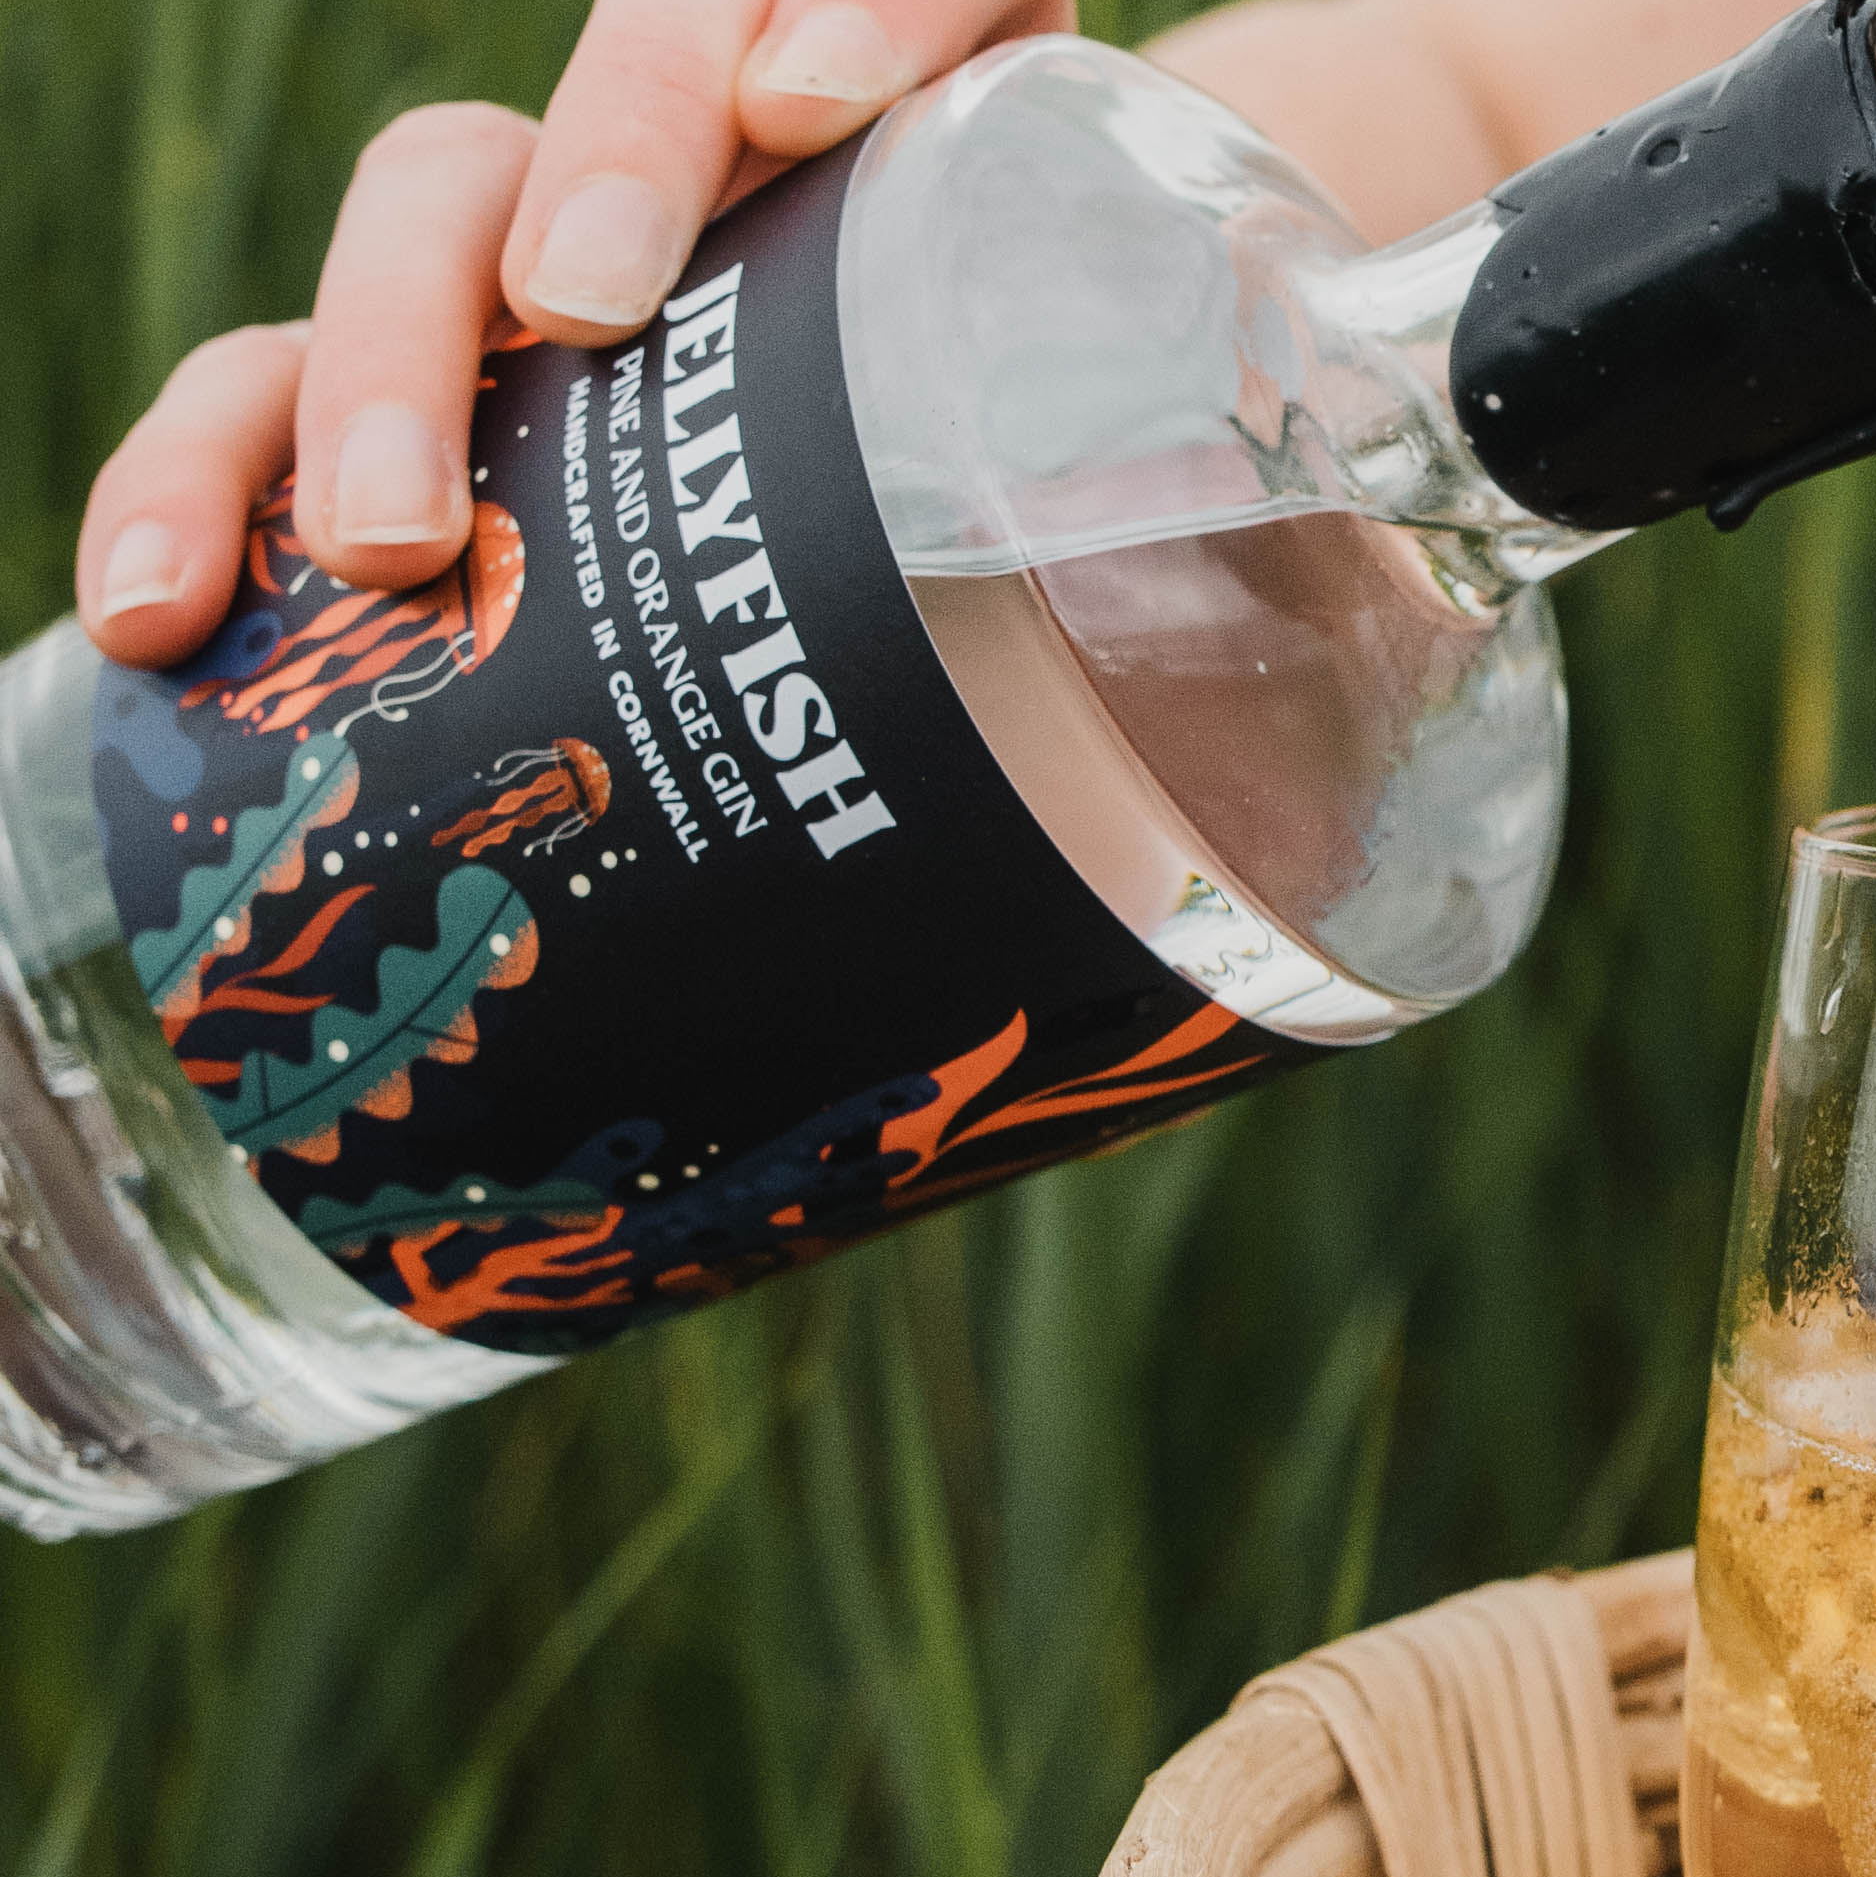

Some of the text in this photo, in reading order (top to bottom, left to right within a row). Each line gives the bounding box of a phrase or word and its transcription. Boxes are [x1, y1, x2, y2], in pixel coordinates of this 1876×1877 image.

[563, 375, 709, 863] HANDCRAFTED IN CORNWALL
[608, 346, 768, 837] PINE AND ORANGE GIN
[663, 262, 897, 861] JELLYFISH
